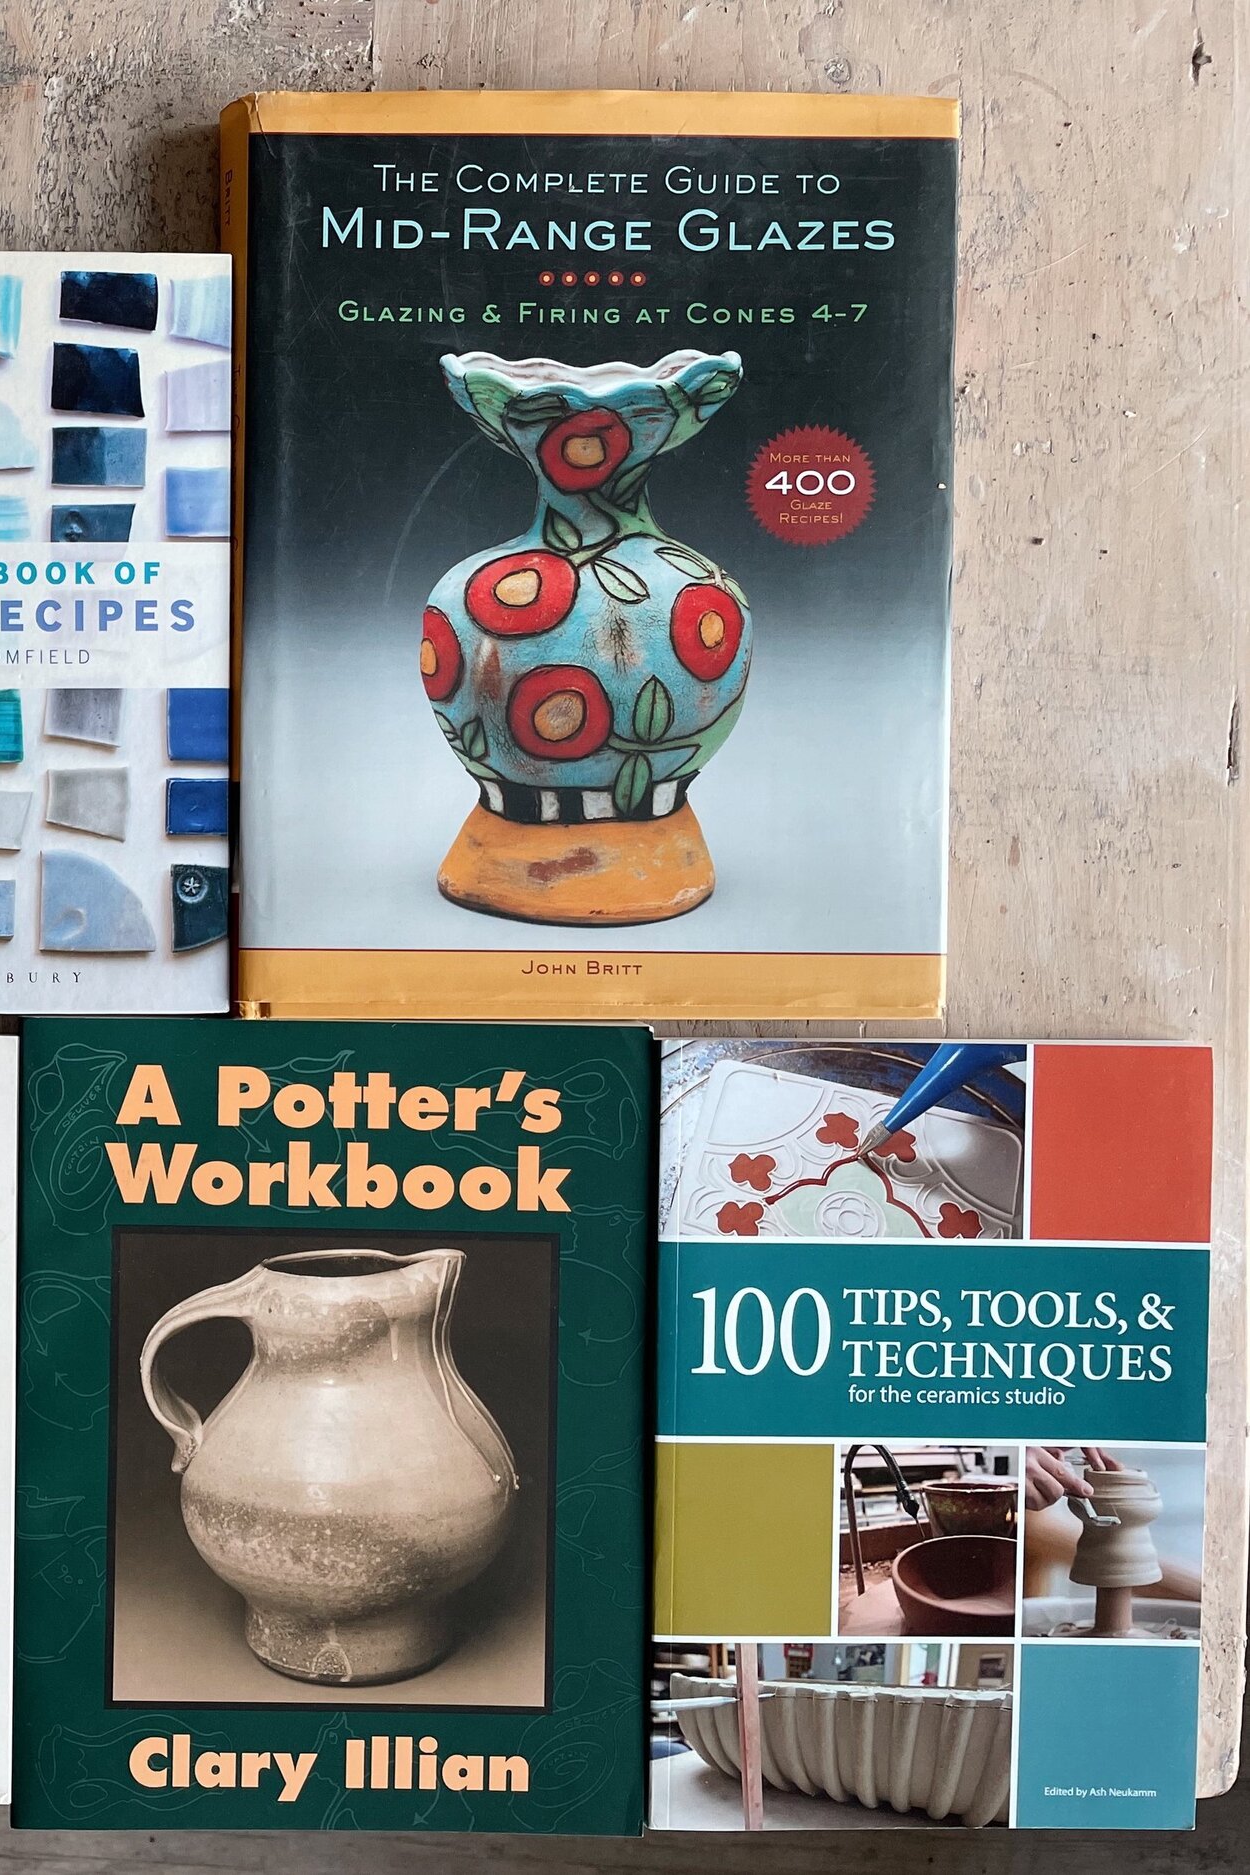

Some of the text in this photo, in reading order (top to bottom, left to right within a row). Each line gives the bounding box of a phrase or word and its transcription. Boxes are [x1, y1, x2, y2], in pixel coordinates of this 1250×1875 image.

[373, 164, 841, 195] THE COMPLETE GUIDE TO
[322, 206, 896, 252] MID-RANGE GLAZES
[338, 300, 466, 323] GLAZING
[481, 303, 501, 324] &
[518, 302, 621, 324] FIRING
[635, 306, 670, 324] AT
[685, 303, 795, 325] CONES
[770, 453, 850, 463] MORE THAN
[765, 470, 855, 496] 400
[790, 500, 831, 510] GLAZE
[780, 513, 842, 523] RECIPES!
[114, 562, 161, 584] OF
[521, 960, 642, 975] JOHN BRITT
[115, 1064, 562, 1134] A Potter's
[104, 1141, 572, 1213] Workbook
[690, 1287, 1176, 1376] 100 TIPS, TOOLS, &
[841, 1340, 1174, 1388] TECHNIQUES
[848, 1383, 1067, 1406] for the ceramics studio
[128, 1733, 531, 1802] Clary Illian
[1044, 1786, 1157, 1798] Edited by Ash Neukamm
